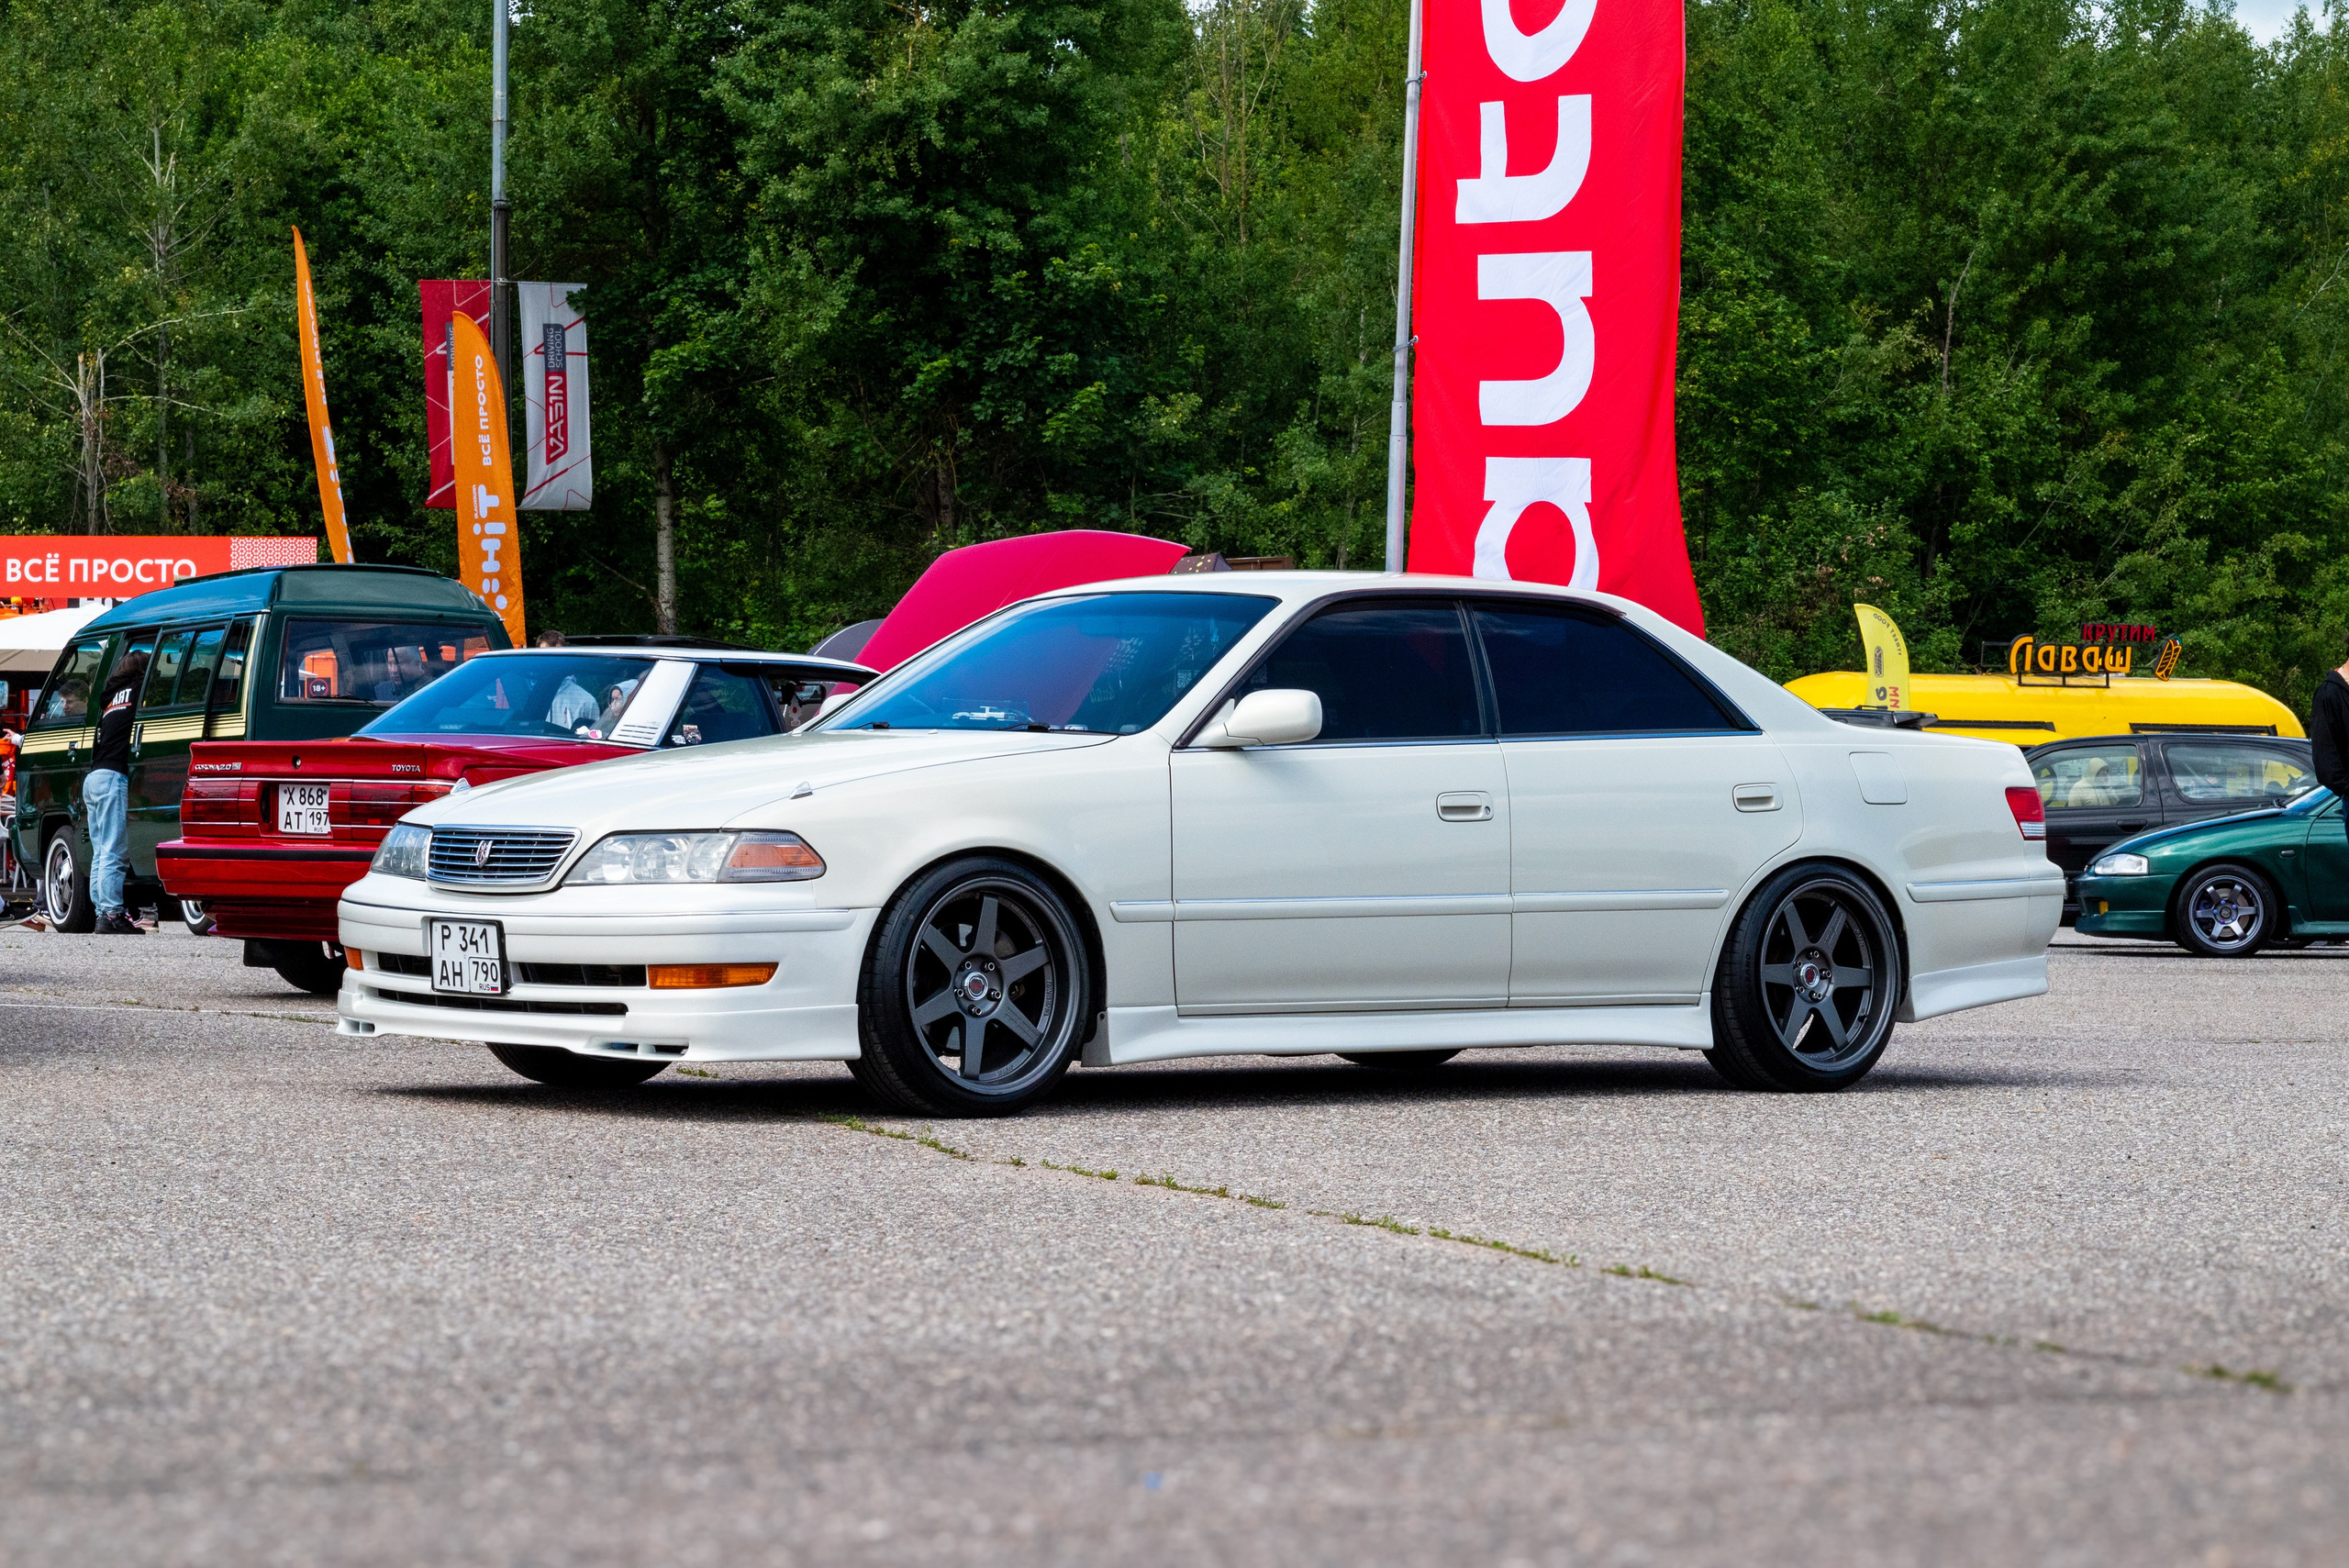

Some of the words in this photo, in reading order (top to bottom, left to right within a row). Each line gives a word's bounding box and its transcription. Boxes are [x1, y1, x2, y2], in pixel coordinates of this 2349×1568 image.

[546, 328, 555, 369] DRIVING
[554, 328, 563, 369] SCHOOL
[474, 354, 490, 430] ПРОСТО
[548, 375, 564, 460] VASIN
[479, 434, 493, 466] ВСЁ
[6, 552, 60, 583] ВСЁ
[69, 558, 197, 583] ПРОСТО
[2082, 624, 2156, 642] КРУТИМ
[2009, 636, 2132, 674] Лаваш
[392, 764, 421, 773] TOYOTA
[299, 787, 324, 806] 868
[309, 811, 328, 826] 197
[459, 926, 489, 954] 341
[472, 961, 498, 983] 790
[478, 983, 491, 992] RUS
